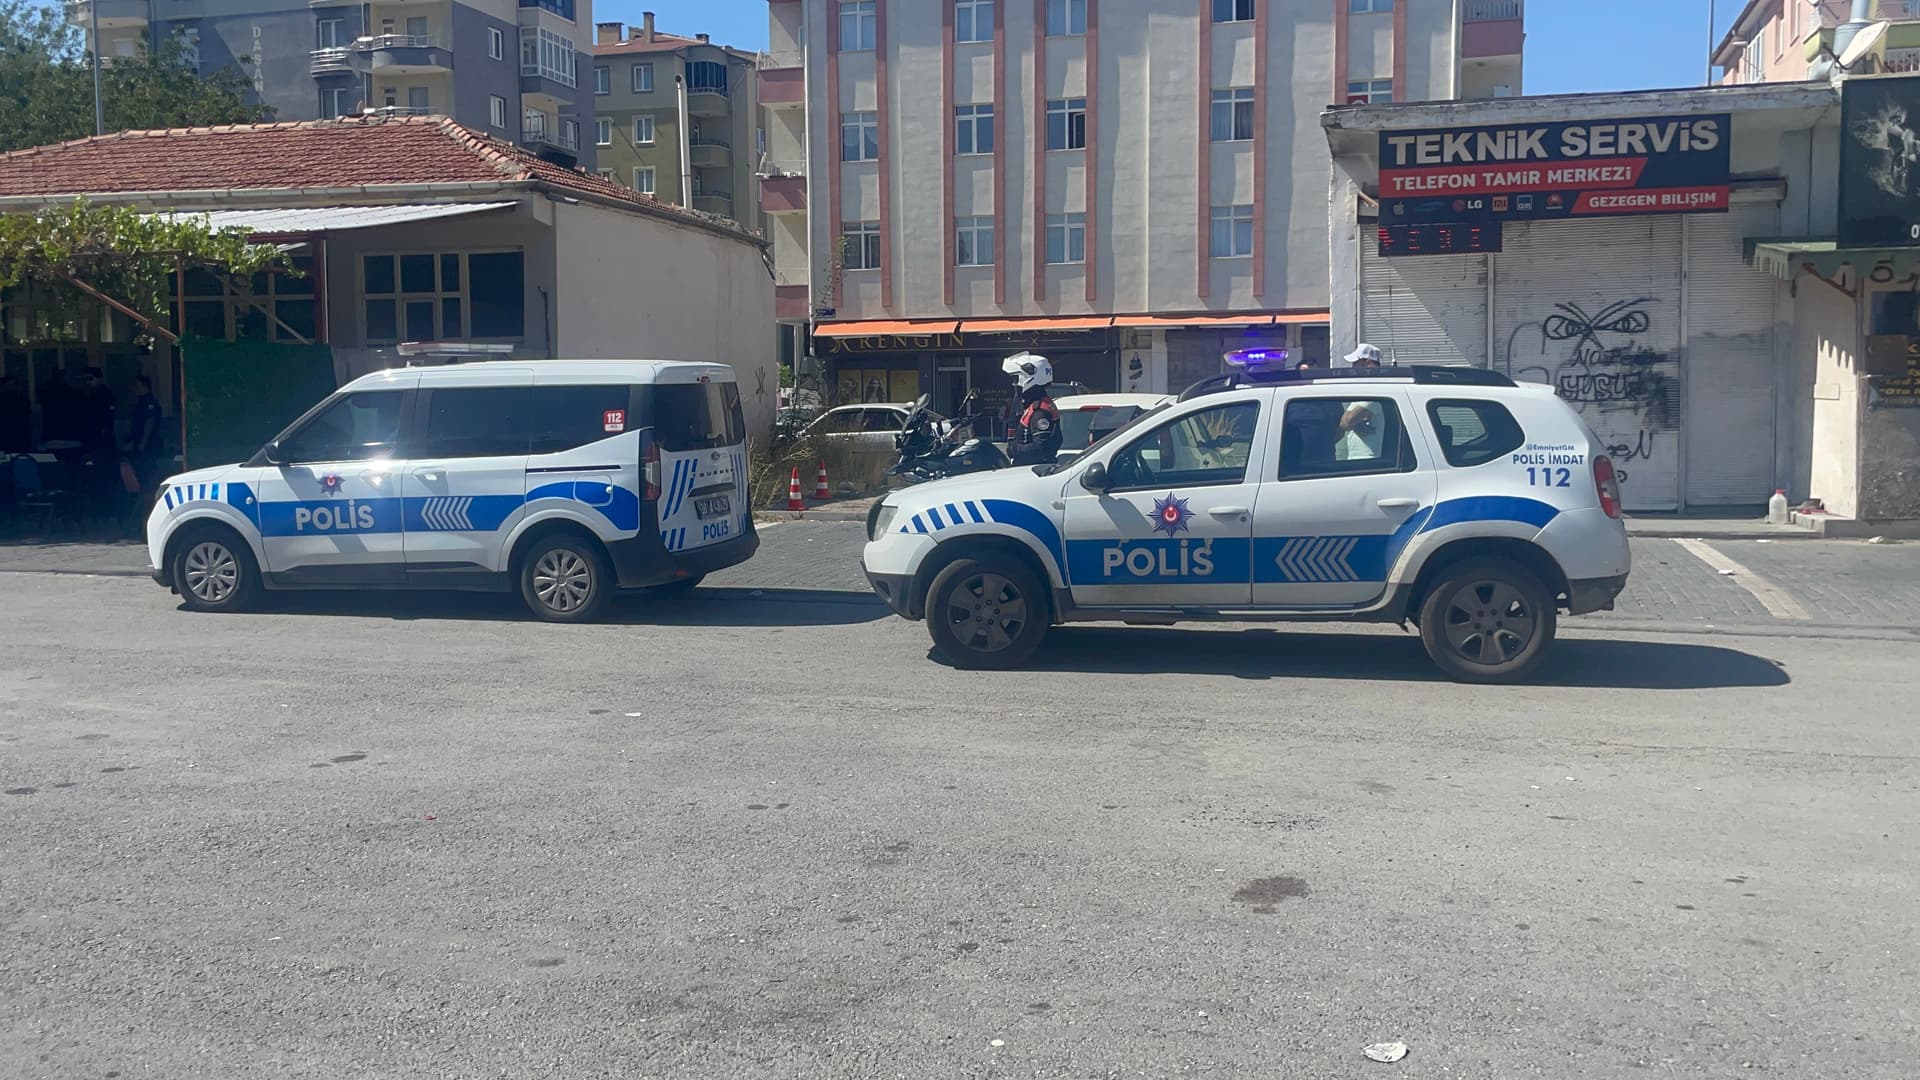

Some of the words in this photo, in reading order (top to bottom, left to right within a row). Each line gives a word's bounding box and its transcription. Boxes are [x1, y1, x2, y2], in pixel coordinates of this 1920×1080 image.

[1392, 173, 1476, 192] TELEFON
[1467, 200, 1483, 209] LG
[1589, 194, 1656, 209] GEZEGEN
[607, 412, 622, 424] 112
[1512, 452, 1545, 465] POLİS
[1548, 452, 1584, 465] İMDAT
[1526, 467, 1571, 488] 112
[295, 500, 375, 531] POLİS
[1103, 540, 1214, 577] POLİS
